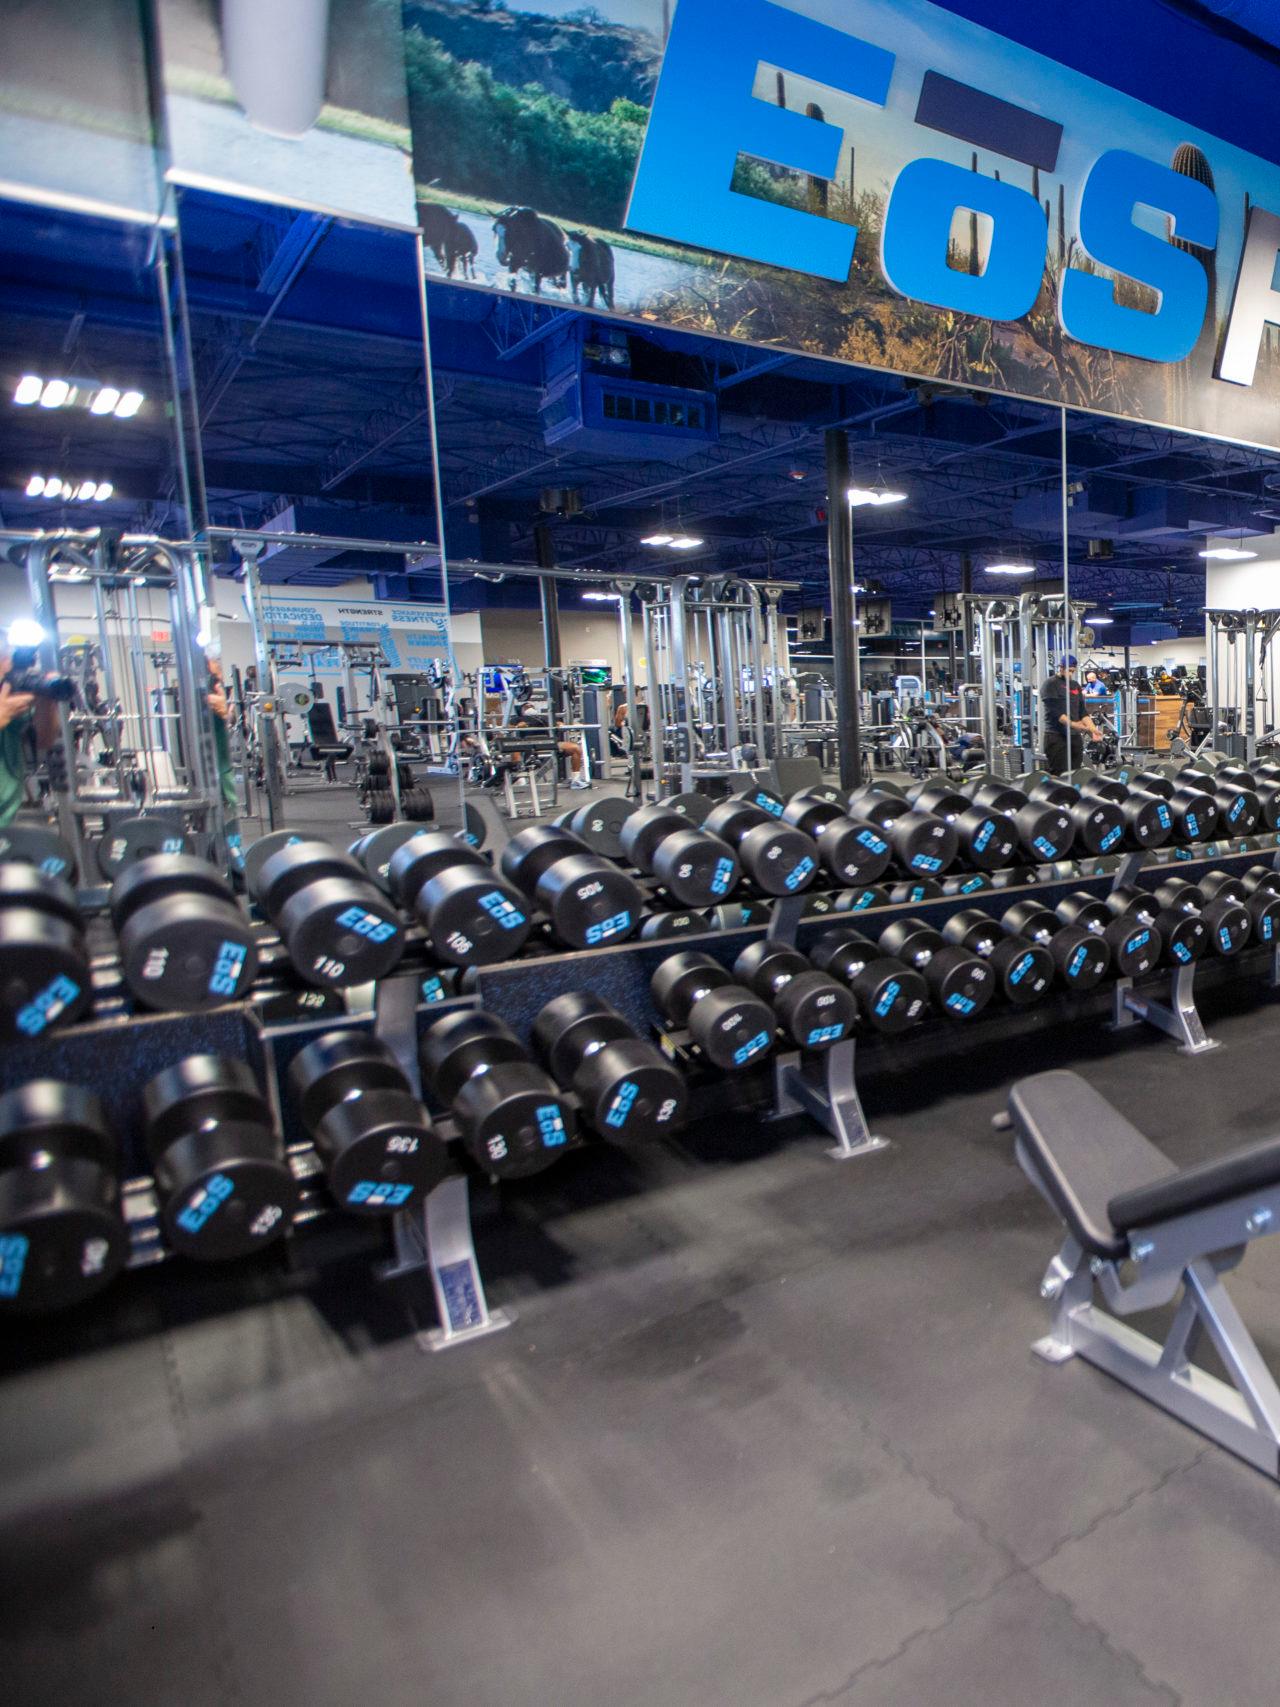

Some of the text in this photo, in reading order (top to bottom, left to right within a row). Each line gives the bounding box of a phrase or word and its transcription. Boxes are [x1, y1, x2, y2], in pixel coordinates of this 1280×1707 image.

[768, 846, 782, 859] 90
[679, 864, 692, 877] 90
[578, 882, 603, 899] 105
[447, 932, 472, 953] 105
[144, 949, 168, 978] 110
[314, 956, 344, 977] 110
[657, 1099, 676, 1121] 130
[488, 1135, 507, 1159] 130
